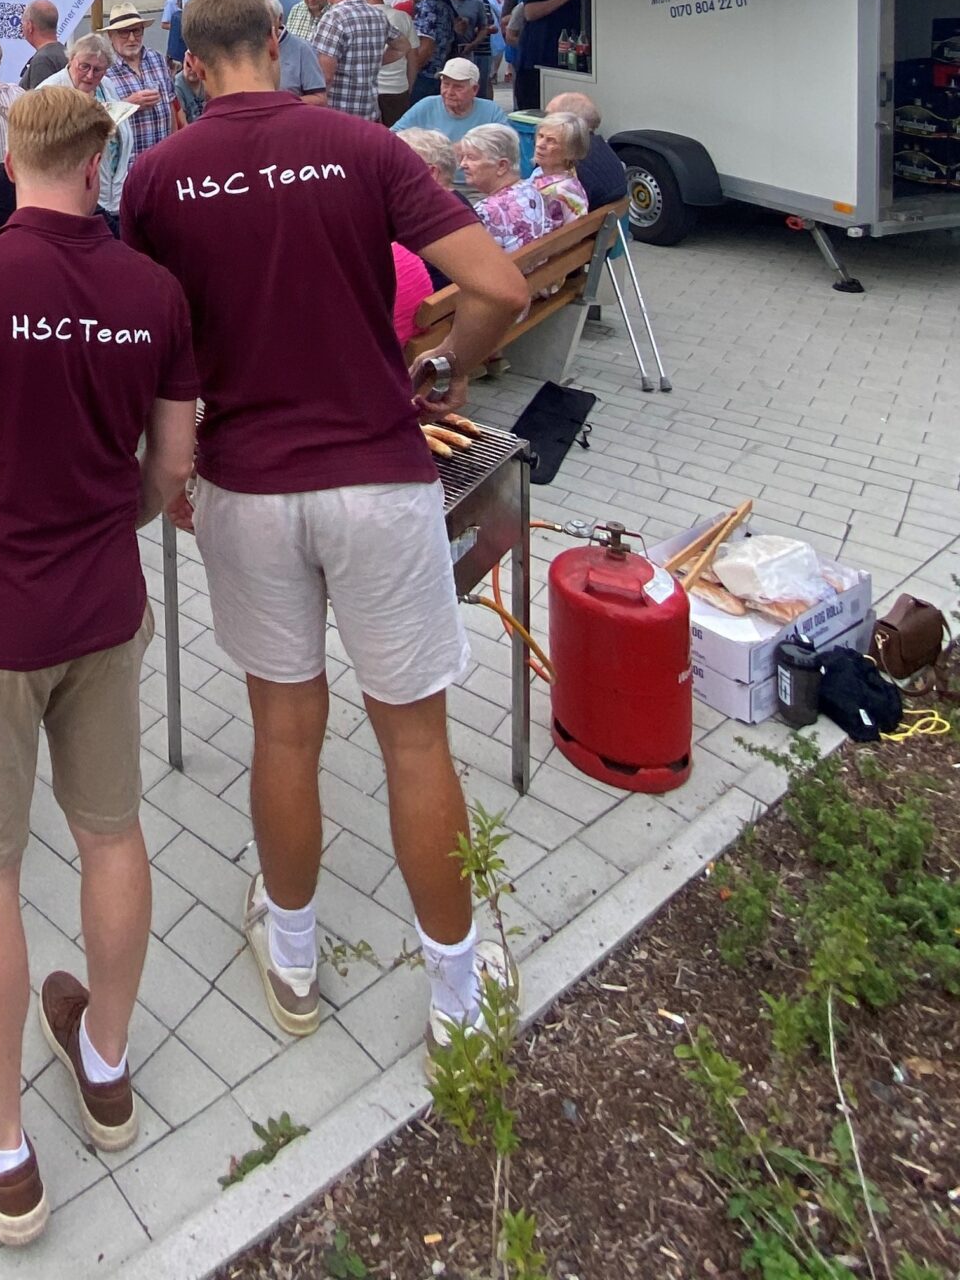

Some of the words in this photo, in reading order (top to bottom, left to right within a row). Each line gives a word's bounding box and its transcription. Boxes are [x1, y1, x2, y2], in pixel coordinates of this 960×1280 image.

[670, 4, 692, 18] 0170
[696, 0, 715, 14] 804
[175, 172, 249, 202] HSC
[259, 162, 346, 190] Team
[11, 315, 72, 340] HSC
[78, 318, 152, 344] Team
